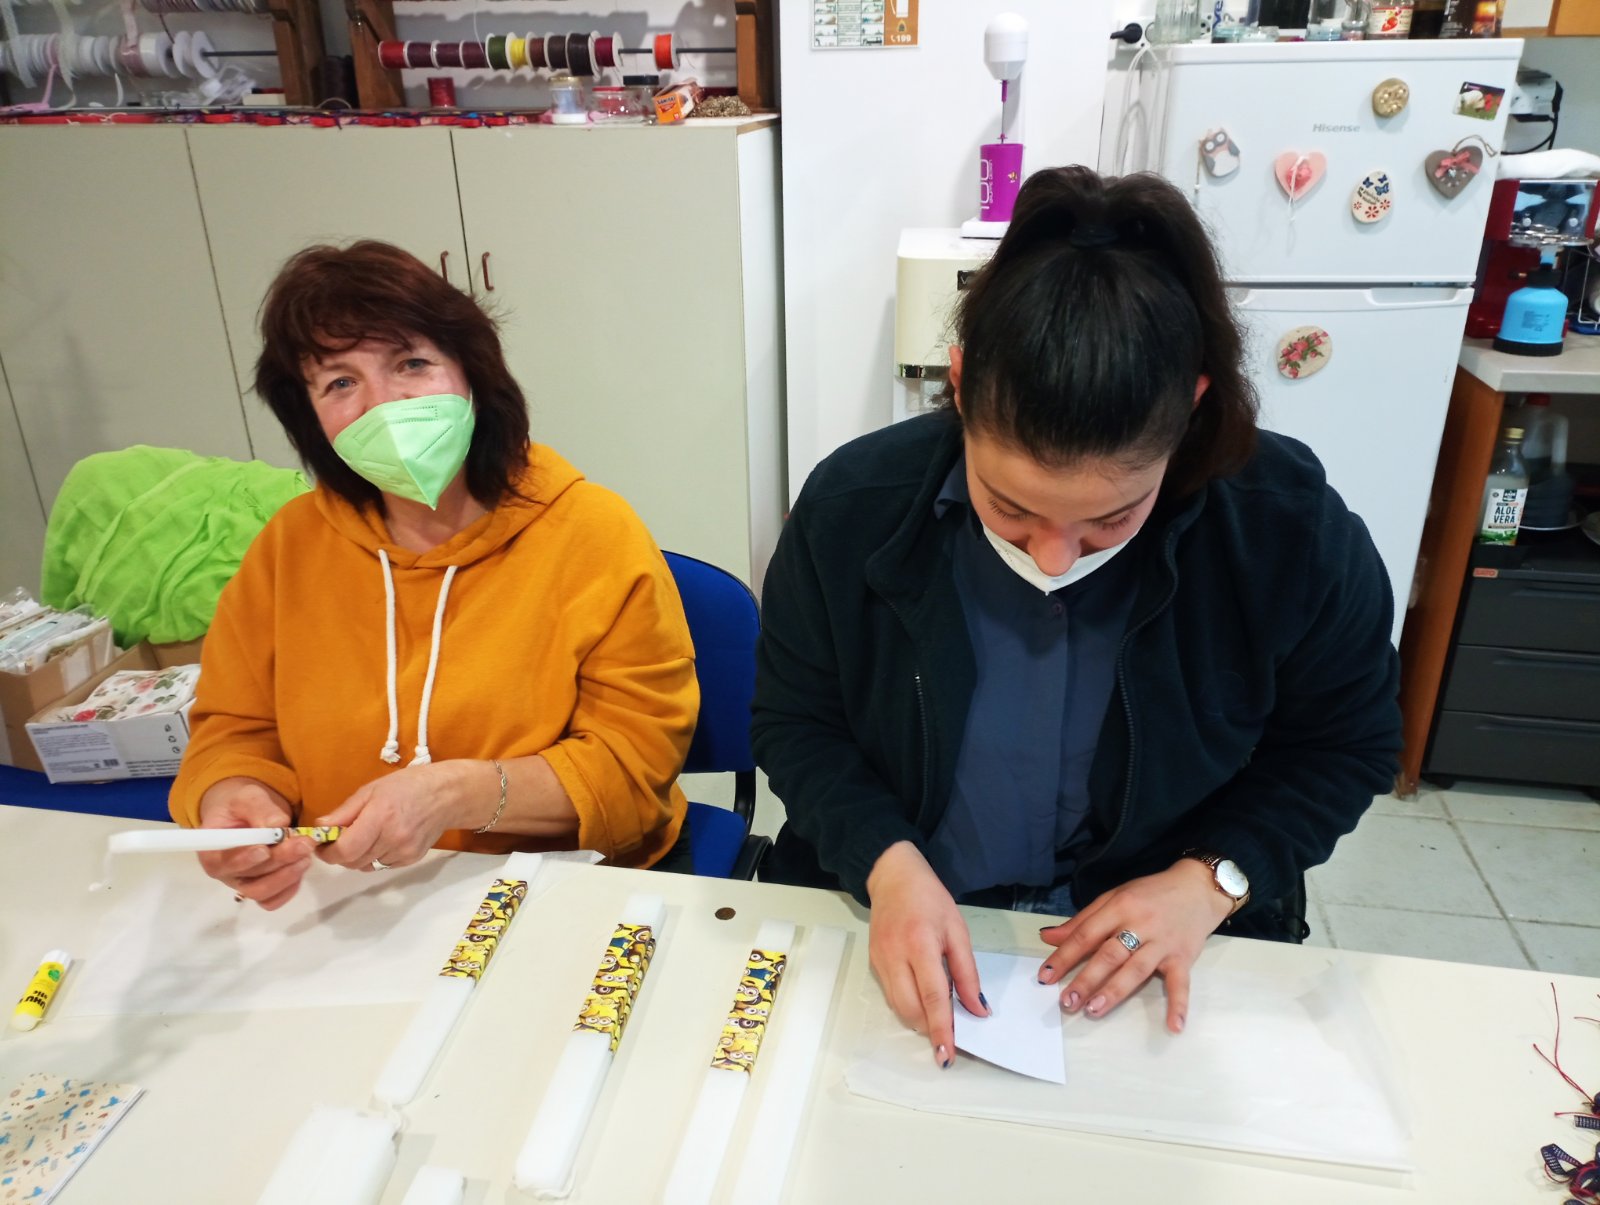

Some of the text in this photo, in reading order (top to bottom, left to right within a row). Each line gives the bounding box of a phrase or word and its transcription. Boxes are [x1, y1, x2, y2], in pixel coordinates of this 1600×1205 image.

[1311, 122, 1361, 133] Hisense
[1494, 505, 1518, 515] ALOE
[1493, 514, 1517, 524] VERA
[25, 995, 47, 1010] UHU
